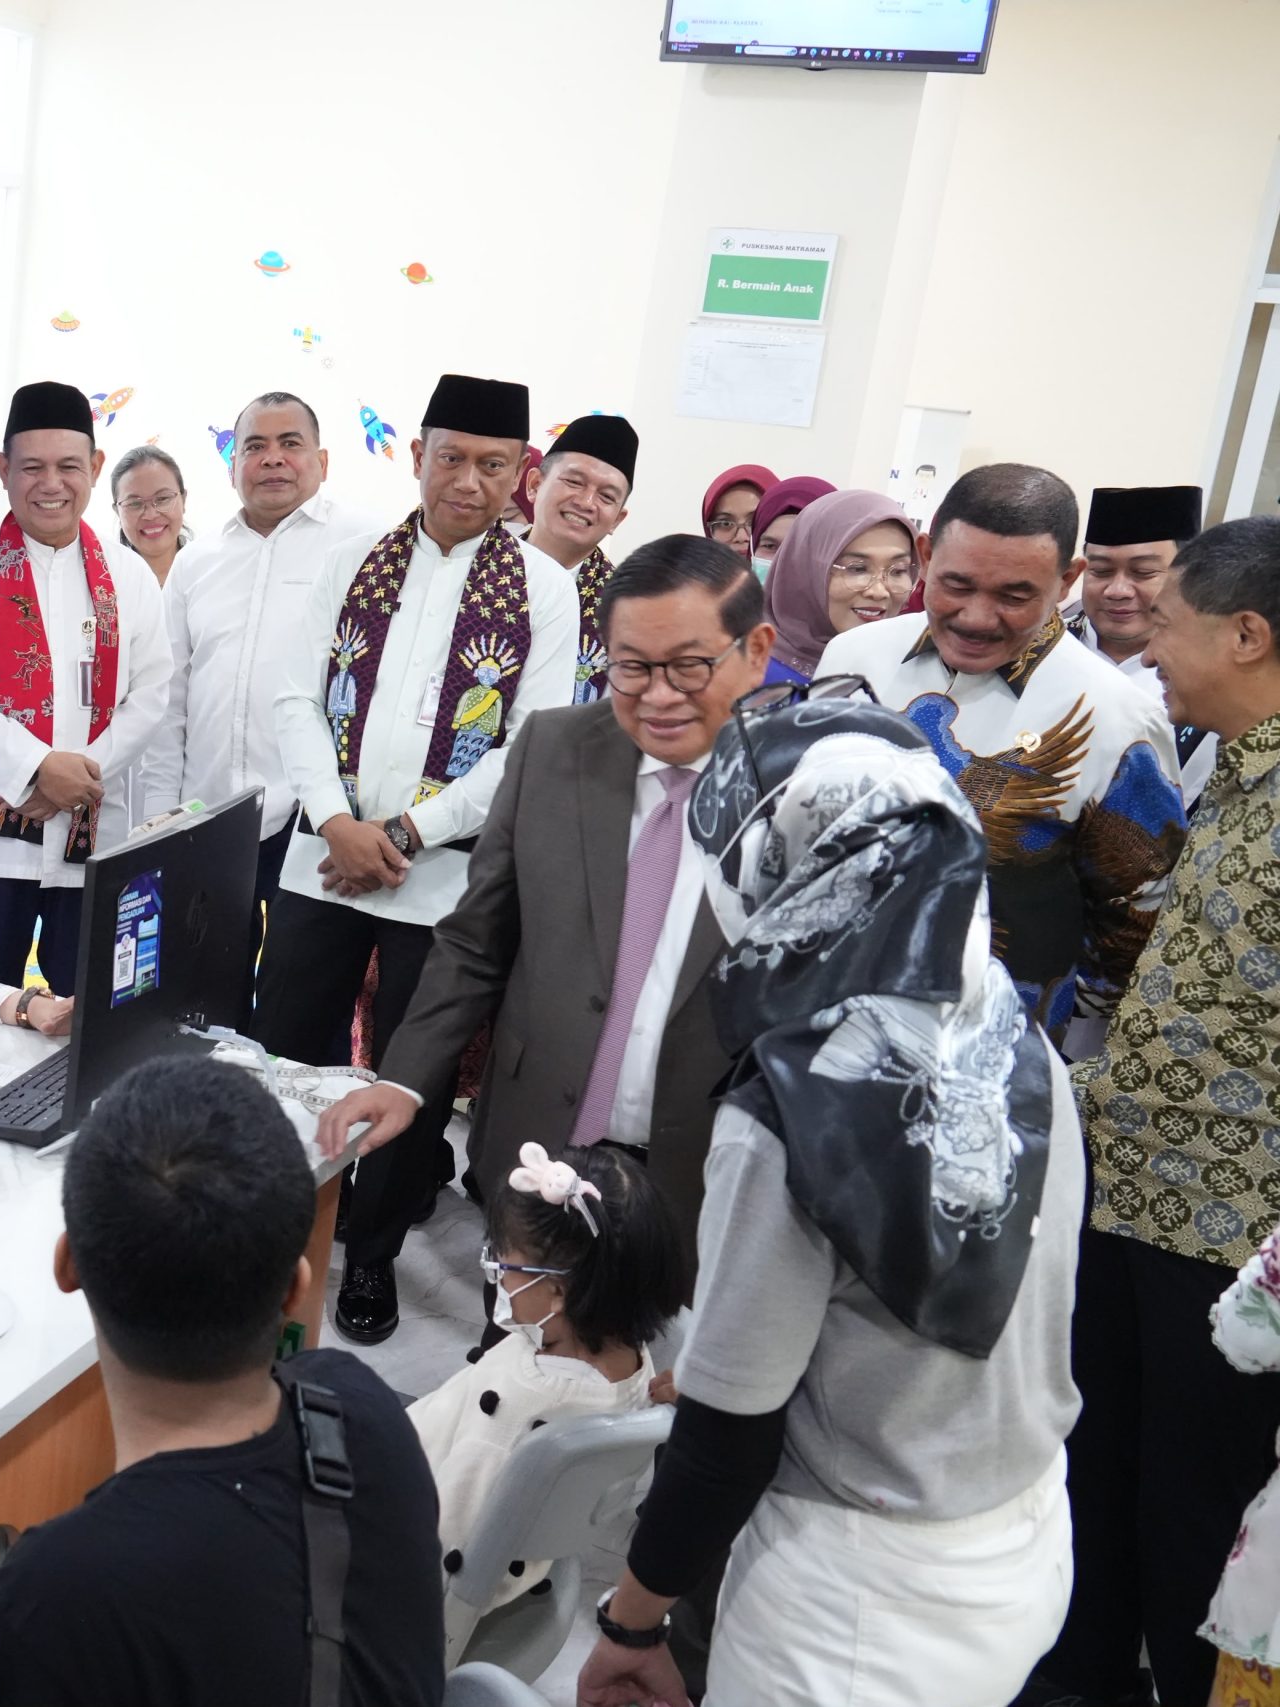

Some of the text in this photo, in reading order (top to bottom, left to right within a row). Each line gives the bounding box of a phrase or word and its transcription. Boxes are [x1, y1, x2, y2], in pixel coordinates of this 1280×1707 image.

[741, 243, 784, 251] PUSKESMAS
[717, 278, 814, 294] R. Bermain Anak
